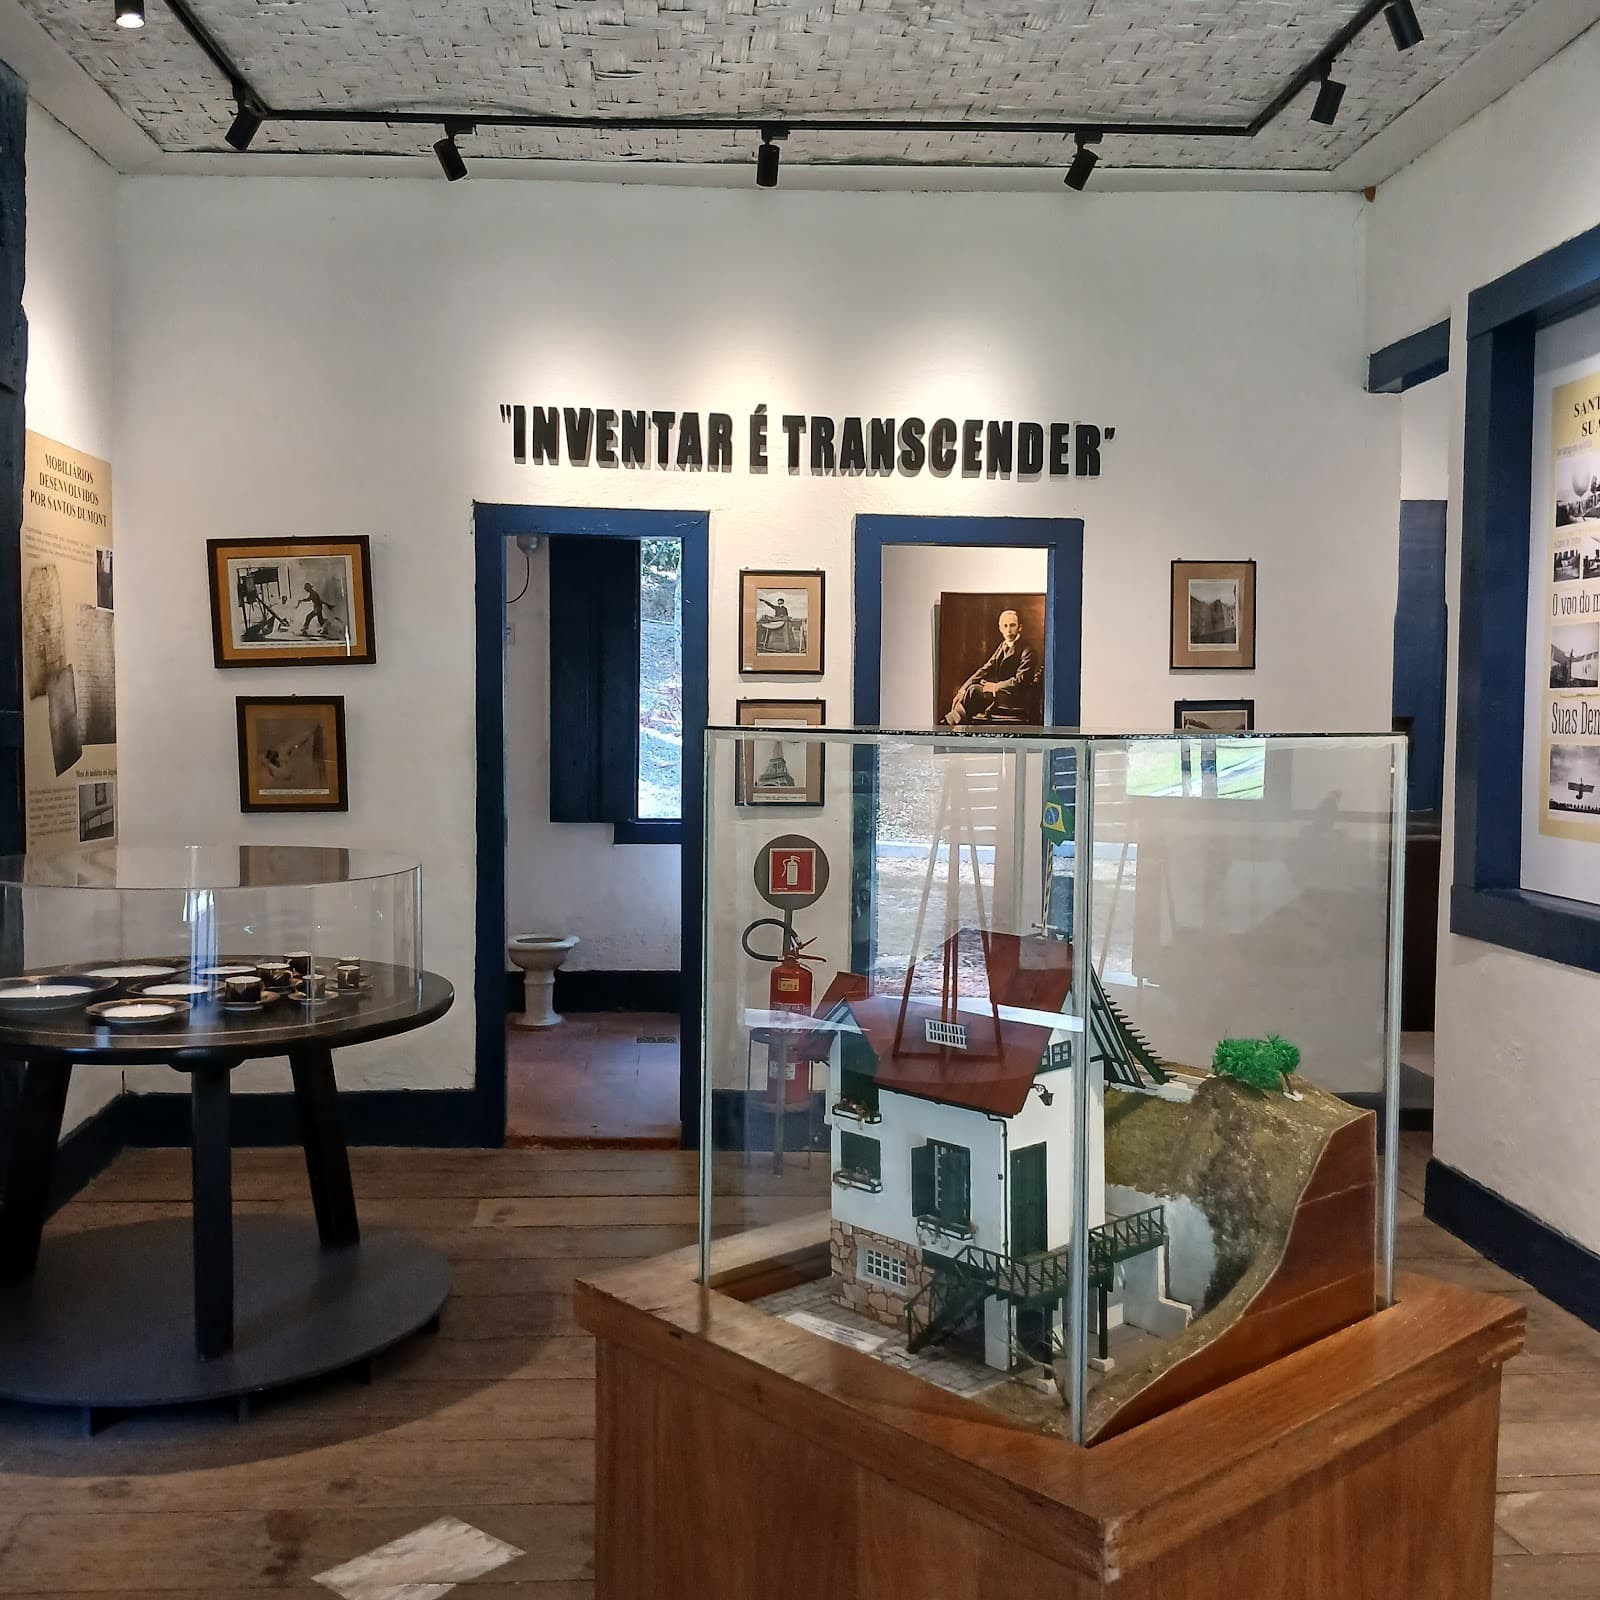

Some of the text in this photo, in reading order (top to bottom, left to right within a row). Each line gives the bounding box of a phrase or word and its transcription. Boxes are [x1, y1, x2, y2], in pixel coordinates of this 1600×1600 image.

[500, 404, 1115, 482] "INVENTAR É TRANSCENDER"
[45, 453, 94, 484] MOBILIÁRIOS
[30, 489, 46, 507] POR
[47, 495, 76, 517] SANTOS
[39, 472, 99, 505] DESENVOLVIDOS
[1552, 593, 1558, 616] O
[1580, 590, 1590, 614] do
[1552, 702, 1577, 734] Suas
